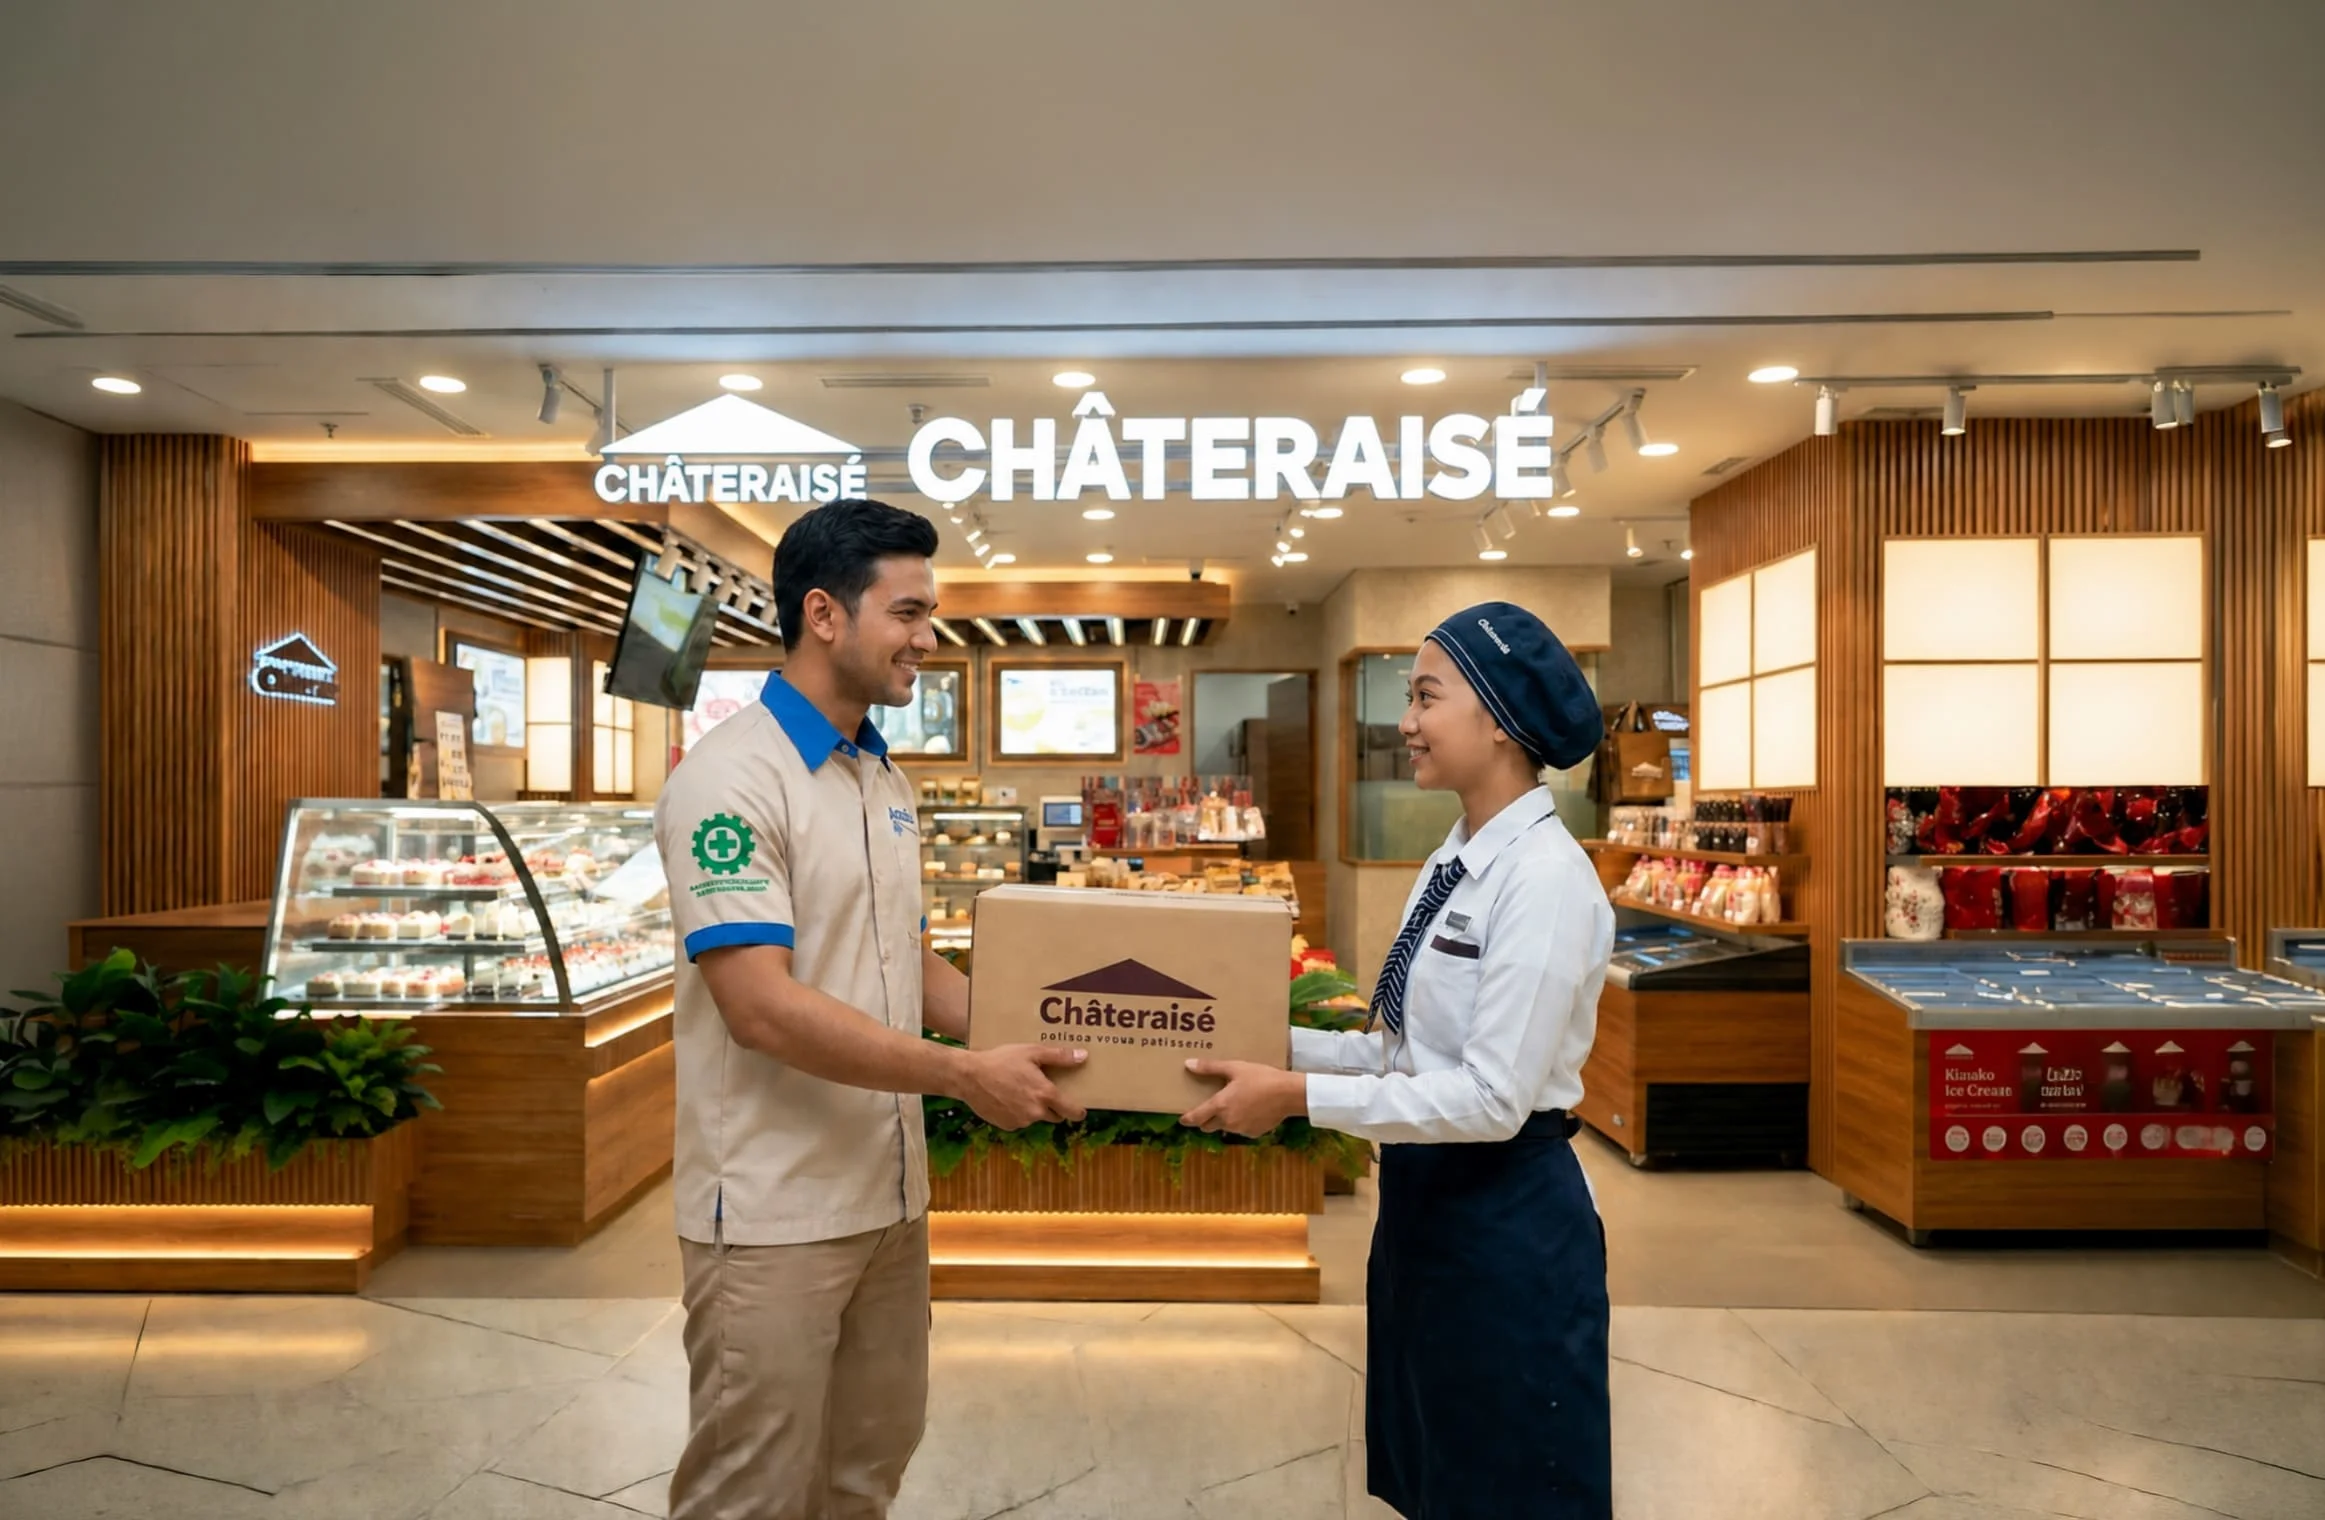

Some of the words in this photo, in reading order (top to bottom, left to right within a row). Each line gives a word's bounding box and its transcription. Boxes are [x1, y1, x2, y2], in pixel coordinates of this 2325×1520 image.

[907, 389, 1553, 501] CHÂTERAISÉ
[594, 454, 867, 502] CHÂTERAISÉ
[1039, 996, 1216, 1032] Châteraisé
[1141, 1037, 1214, 1049] patisserie
[1945, 1084, 1965, 1097] Ice
